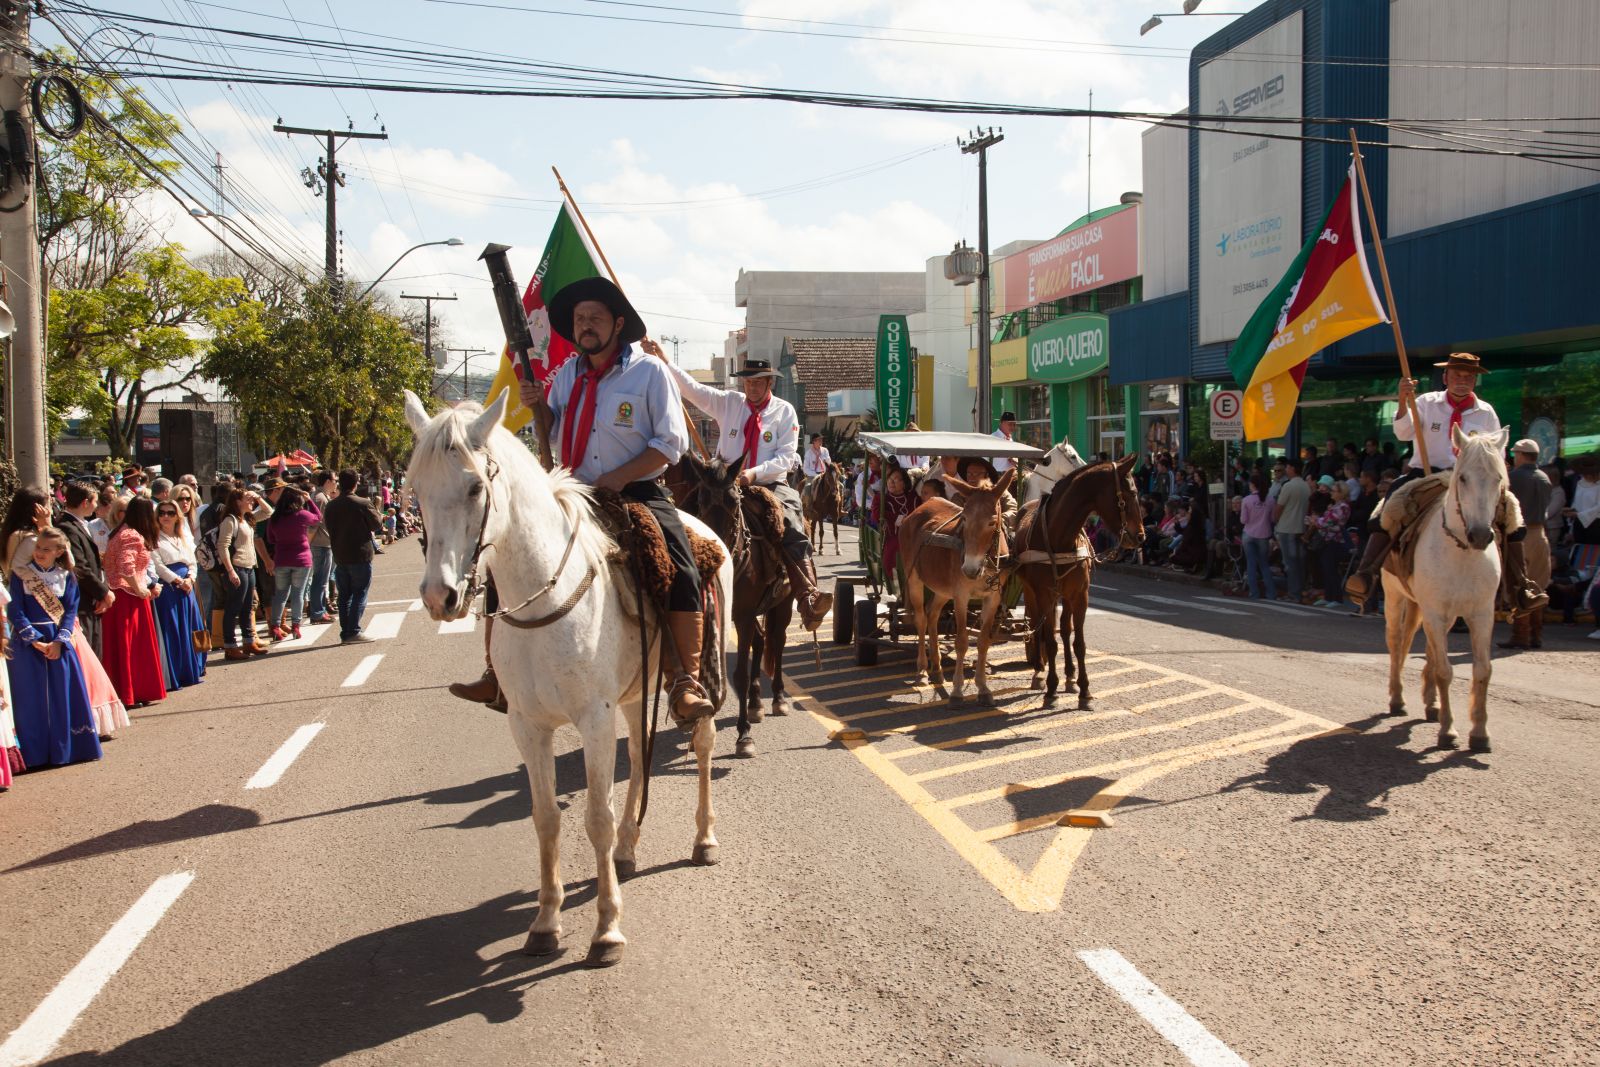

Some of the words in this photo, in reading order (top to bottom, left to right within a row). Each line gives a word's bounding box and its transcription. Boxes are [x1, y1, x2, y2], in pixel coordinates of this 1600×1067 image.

[1233, 74, 1284, 115] SERMED
[1233, 216, 1281, 242] LABORATÓRIO
[1028, 238, 1071, 268] TRANSFORMAR
[1070, 231, 1084, 251] SUA
[1084, 225, 1103, 246] CASA
[1028, 269, 1036, 303] É
[1071, 250, 1104, 290] FÁCIL
[1303, 319, 1317, 335] DO
[1321, 302, 1344, 320] SUL
[1222, 399, 1231, 412] E
[1262, 382, 1276, 412] SUL
